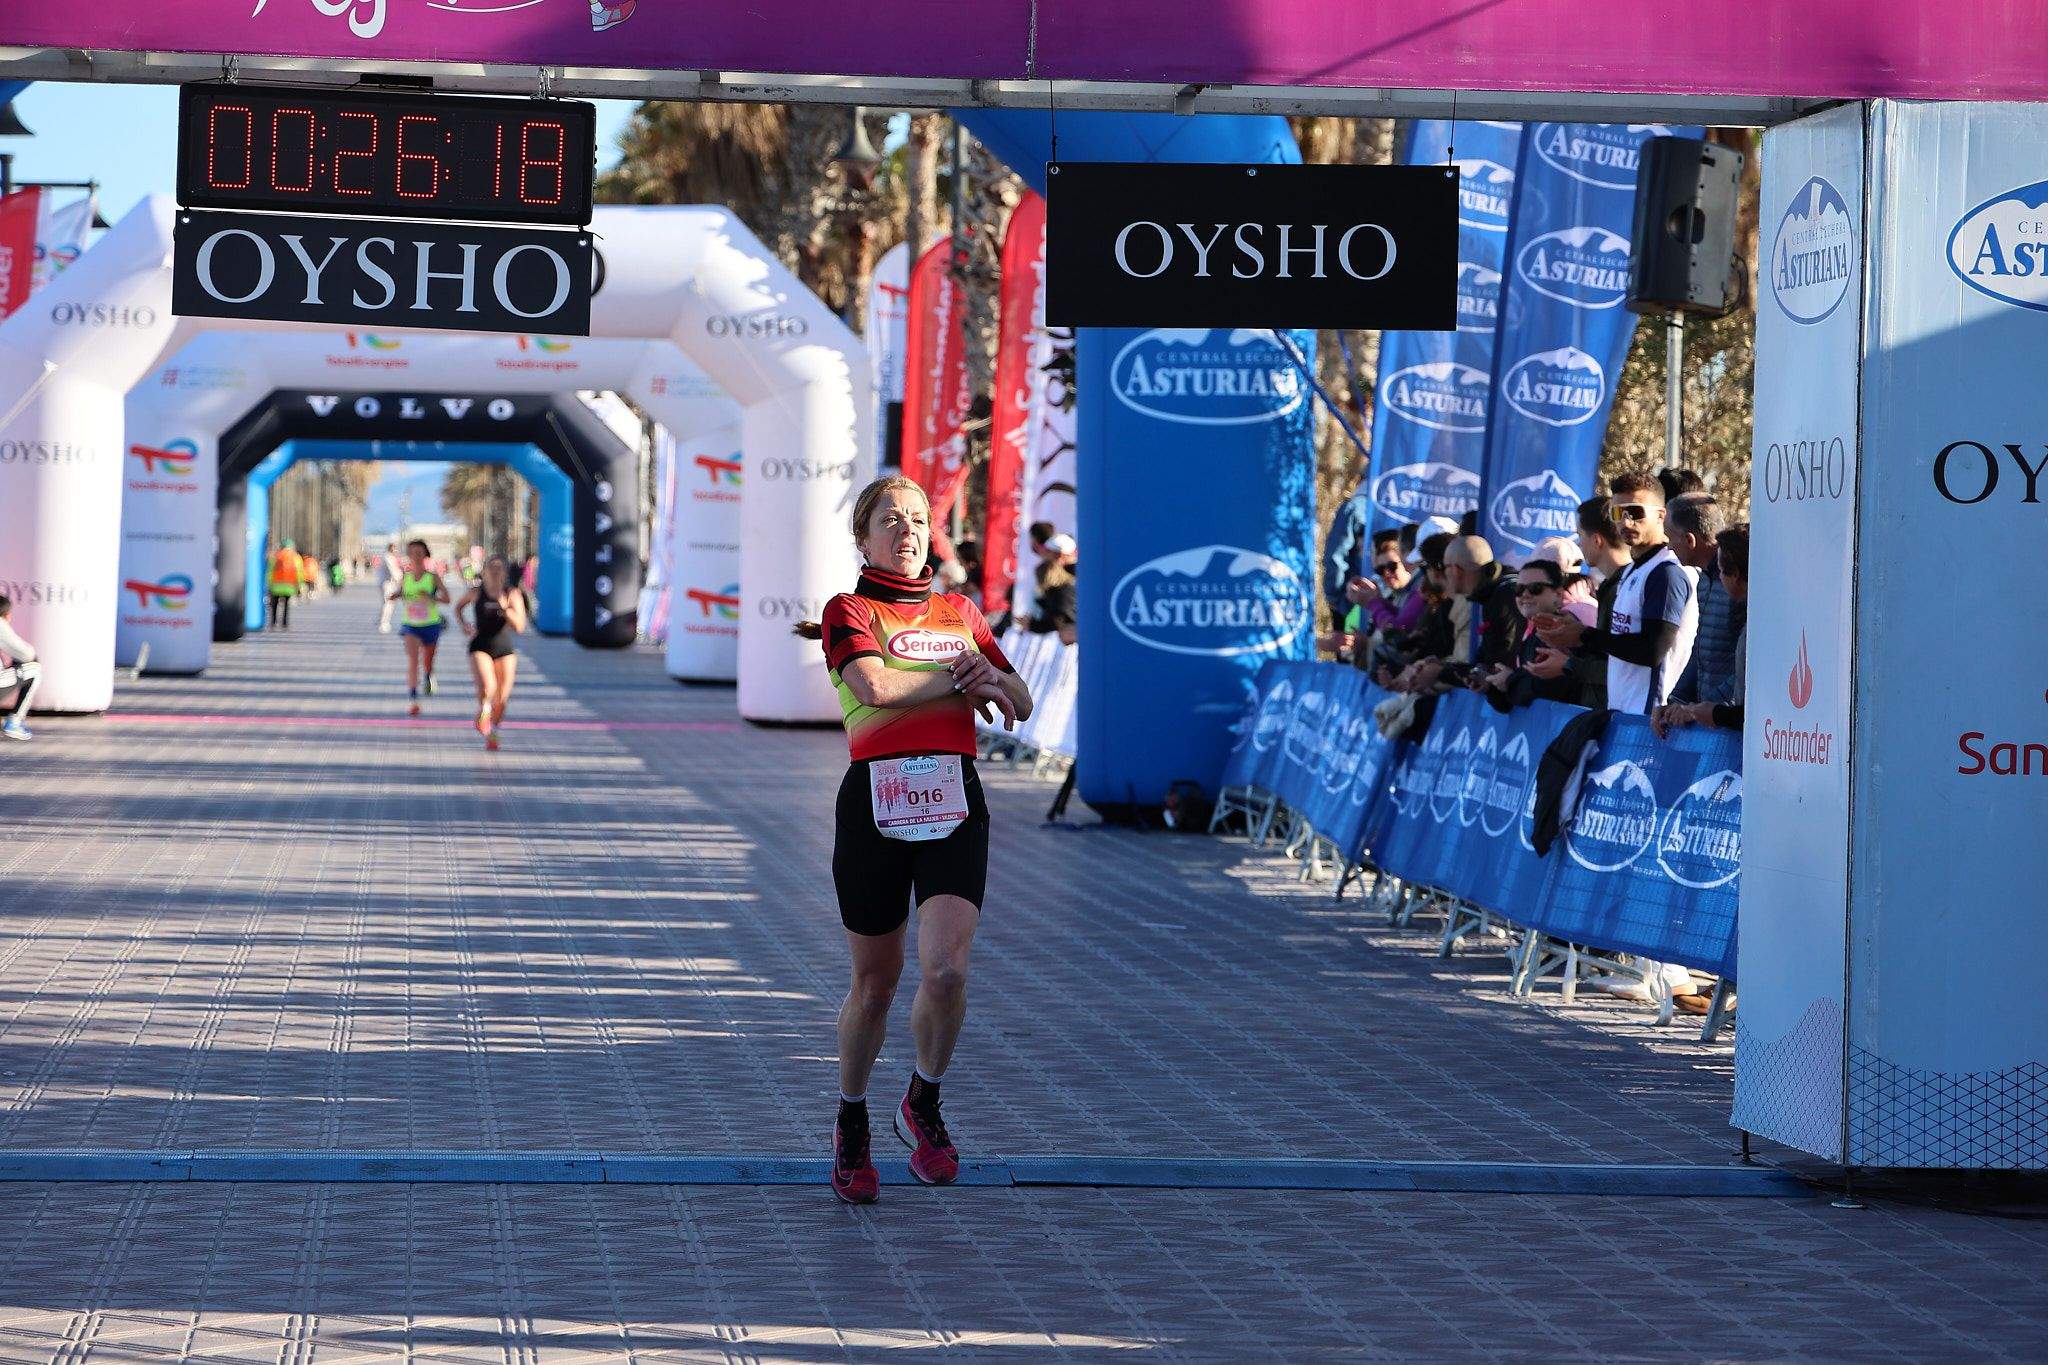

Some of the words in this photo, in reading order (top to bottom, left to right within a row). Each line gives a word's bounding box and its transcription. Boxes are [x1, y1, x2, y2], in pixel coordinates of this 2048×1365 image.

[207, 104, 563, 205] 00:26:18
[1115, 221, 1398, 281] OYSHO
[1777, 237, 1848, 292] ASTURIANA
[196, 229, 571, 319] OYSHO
[52, 302, 155, 329] OYSHO
[707, 314, 808, 338] OYSHO
[1125, 354, 1298, 397] ASTURIAN
[1156, 352, 1228, 364] CENTRAL
[305, 394, 517, 421] VOLVO
[1391, 380, 1486, 418] ASTURIA
[0, 440, 96, 465] OYSHO
[1765, 437, 1845, 503] OYSHO
[1125, 584, 1296, 627] ASTURIAN
[899, 635, 966, 653] Serrano
[1763, 719, 1832, 765] Santander
[907, 788, 944, 806] 016
[1662, 810, 1741, 862] ASTURIAN
